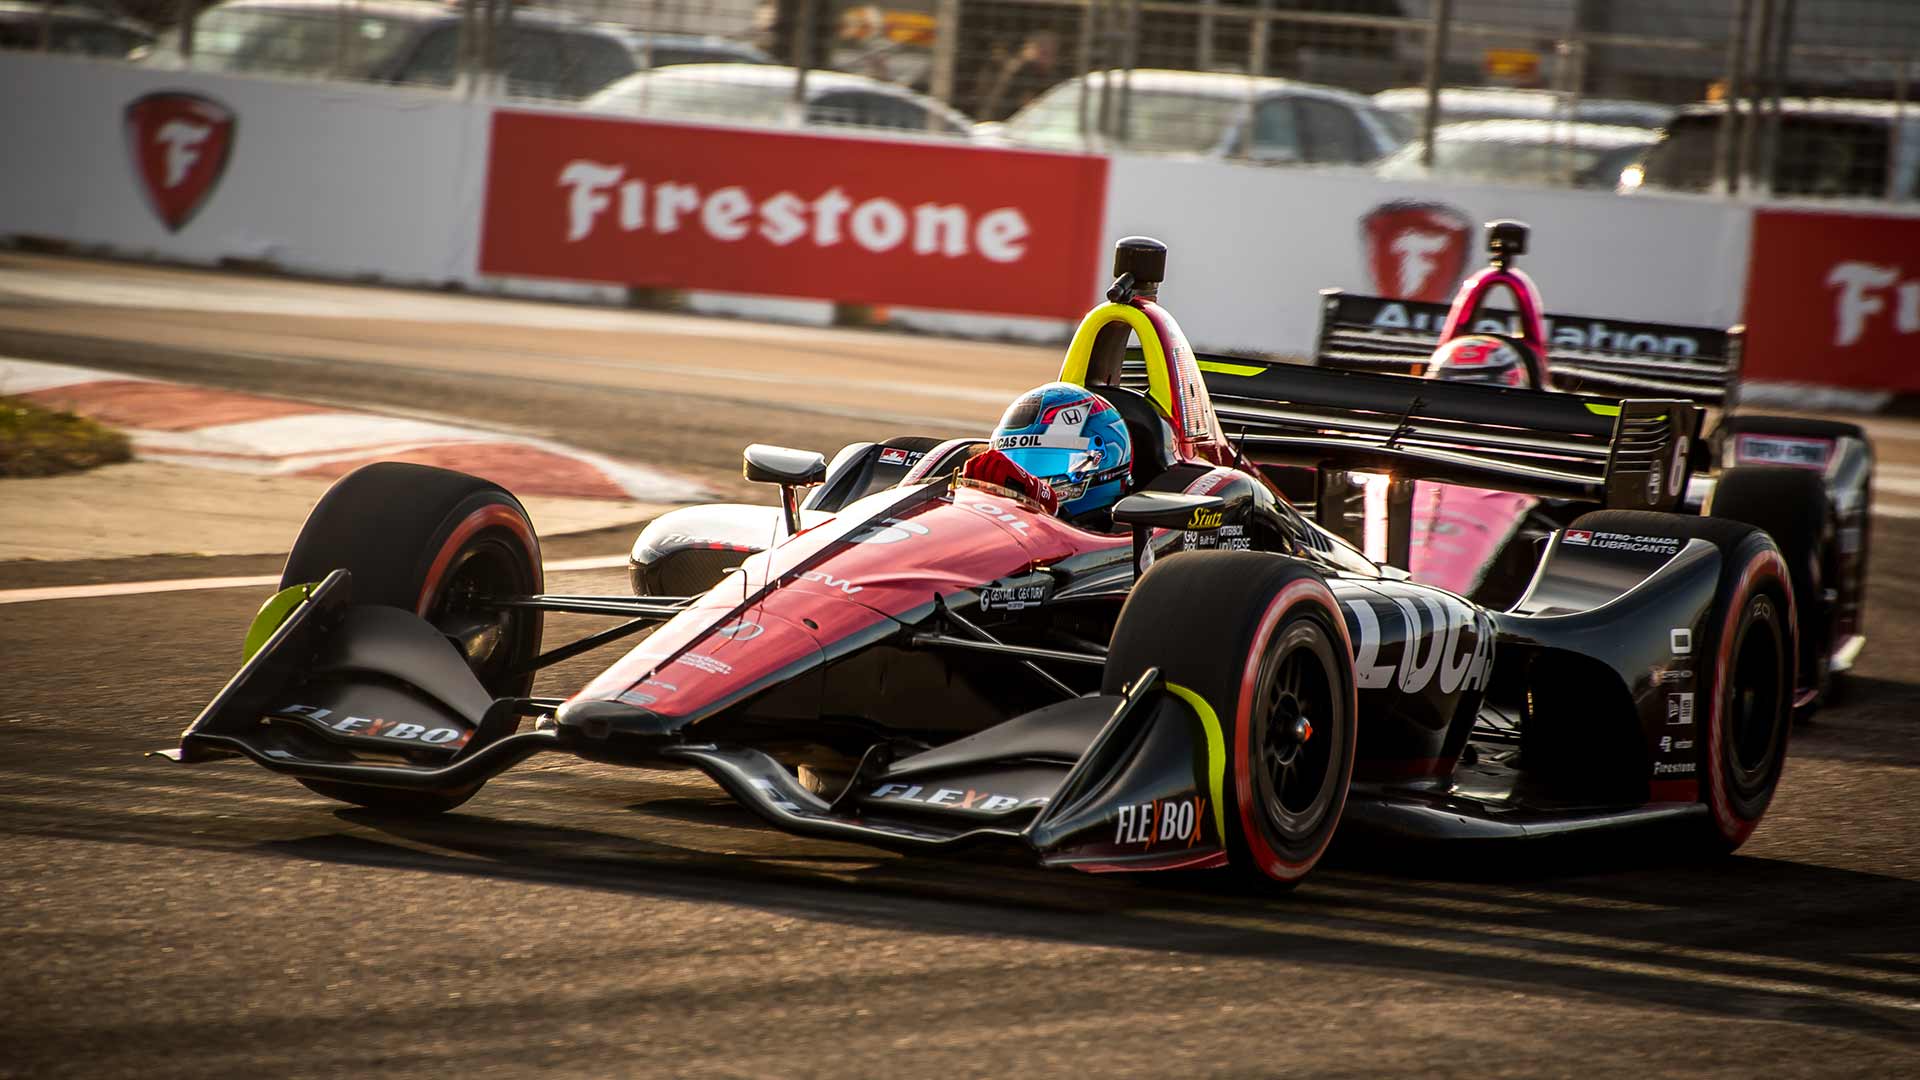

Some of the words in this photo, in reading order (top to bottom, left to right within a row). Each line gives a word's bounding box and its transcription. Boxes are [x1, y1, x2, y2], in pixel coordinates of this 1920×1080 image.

[558, 160, 1030, 263] Firestone
[991, 435, 1017, 449] CAS
[1019, 435, 1041, 447] OIL
[1669, 435, 1689, 496] 6
[973, 503, 1031, 537] OIL
[1188, 507, 1223, 529] Stutz
[1591, 539, 1678, 555] LUBRICANTS
[1594, 532, 1680, 546] PETRO-CANADA
[871, 783, 1046, 811] FLEXB
[1115, 795, 1206, 849] FLEXBOX
